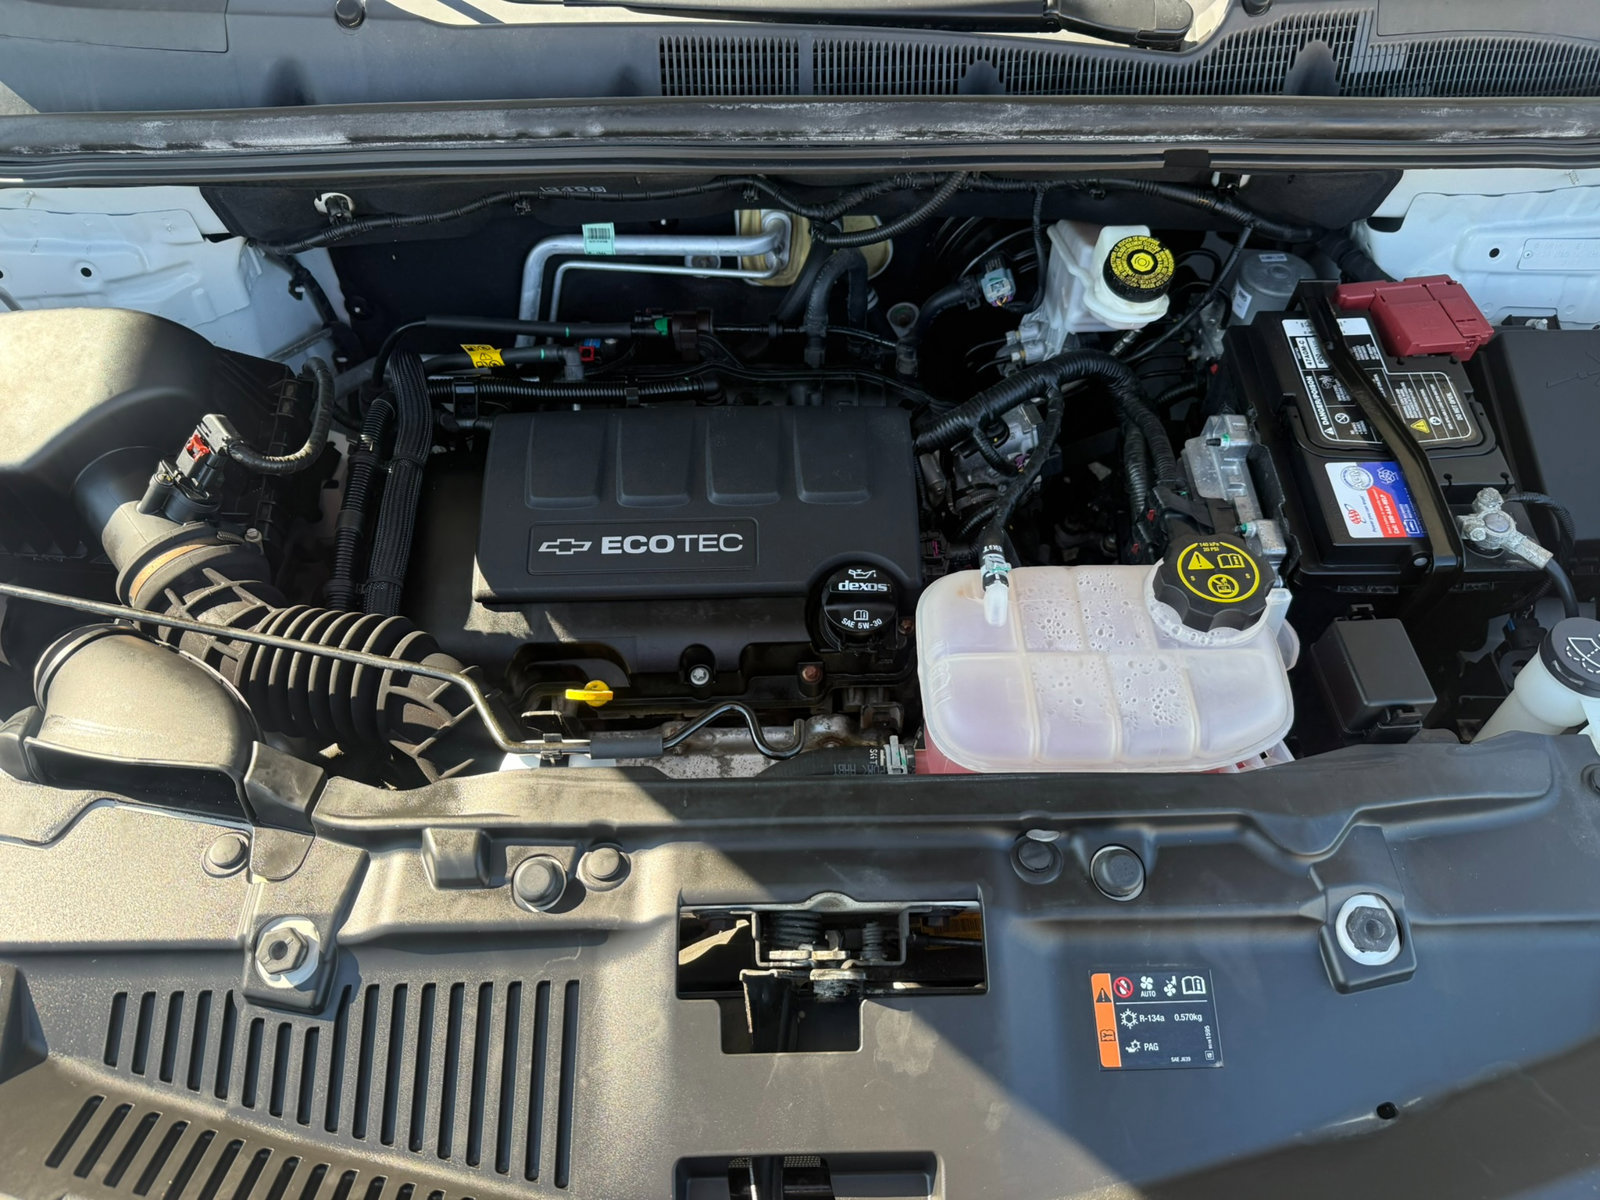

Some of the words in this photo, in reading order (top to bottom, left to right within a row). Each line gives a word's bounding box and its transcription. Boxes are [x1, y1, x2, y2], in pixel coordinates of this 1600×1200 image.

[1306, 375, 1330, 426] DANGER/POISON
[601, 533, 744, 555] ECOTEC
[838, 580, 888, 592] dexos
[841, 617, 856, 629] SAE
[857, 618, 883, 630] 5W-30
[1140, 990, 1156, 998] AUTO
[1139, 1014, 1165, 1022] R-134a
[1174, 1013, 1203, 1022] 0.570kg
[1144, 1043, 1159, 1051] PAG
